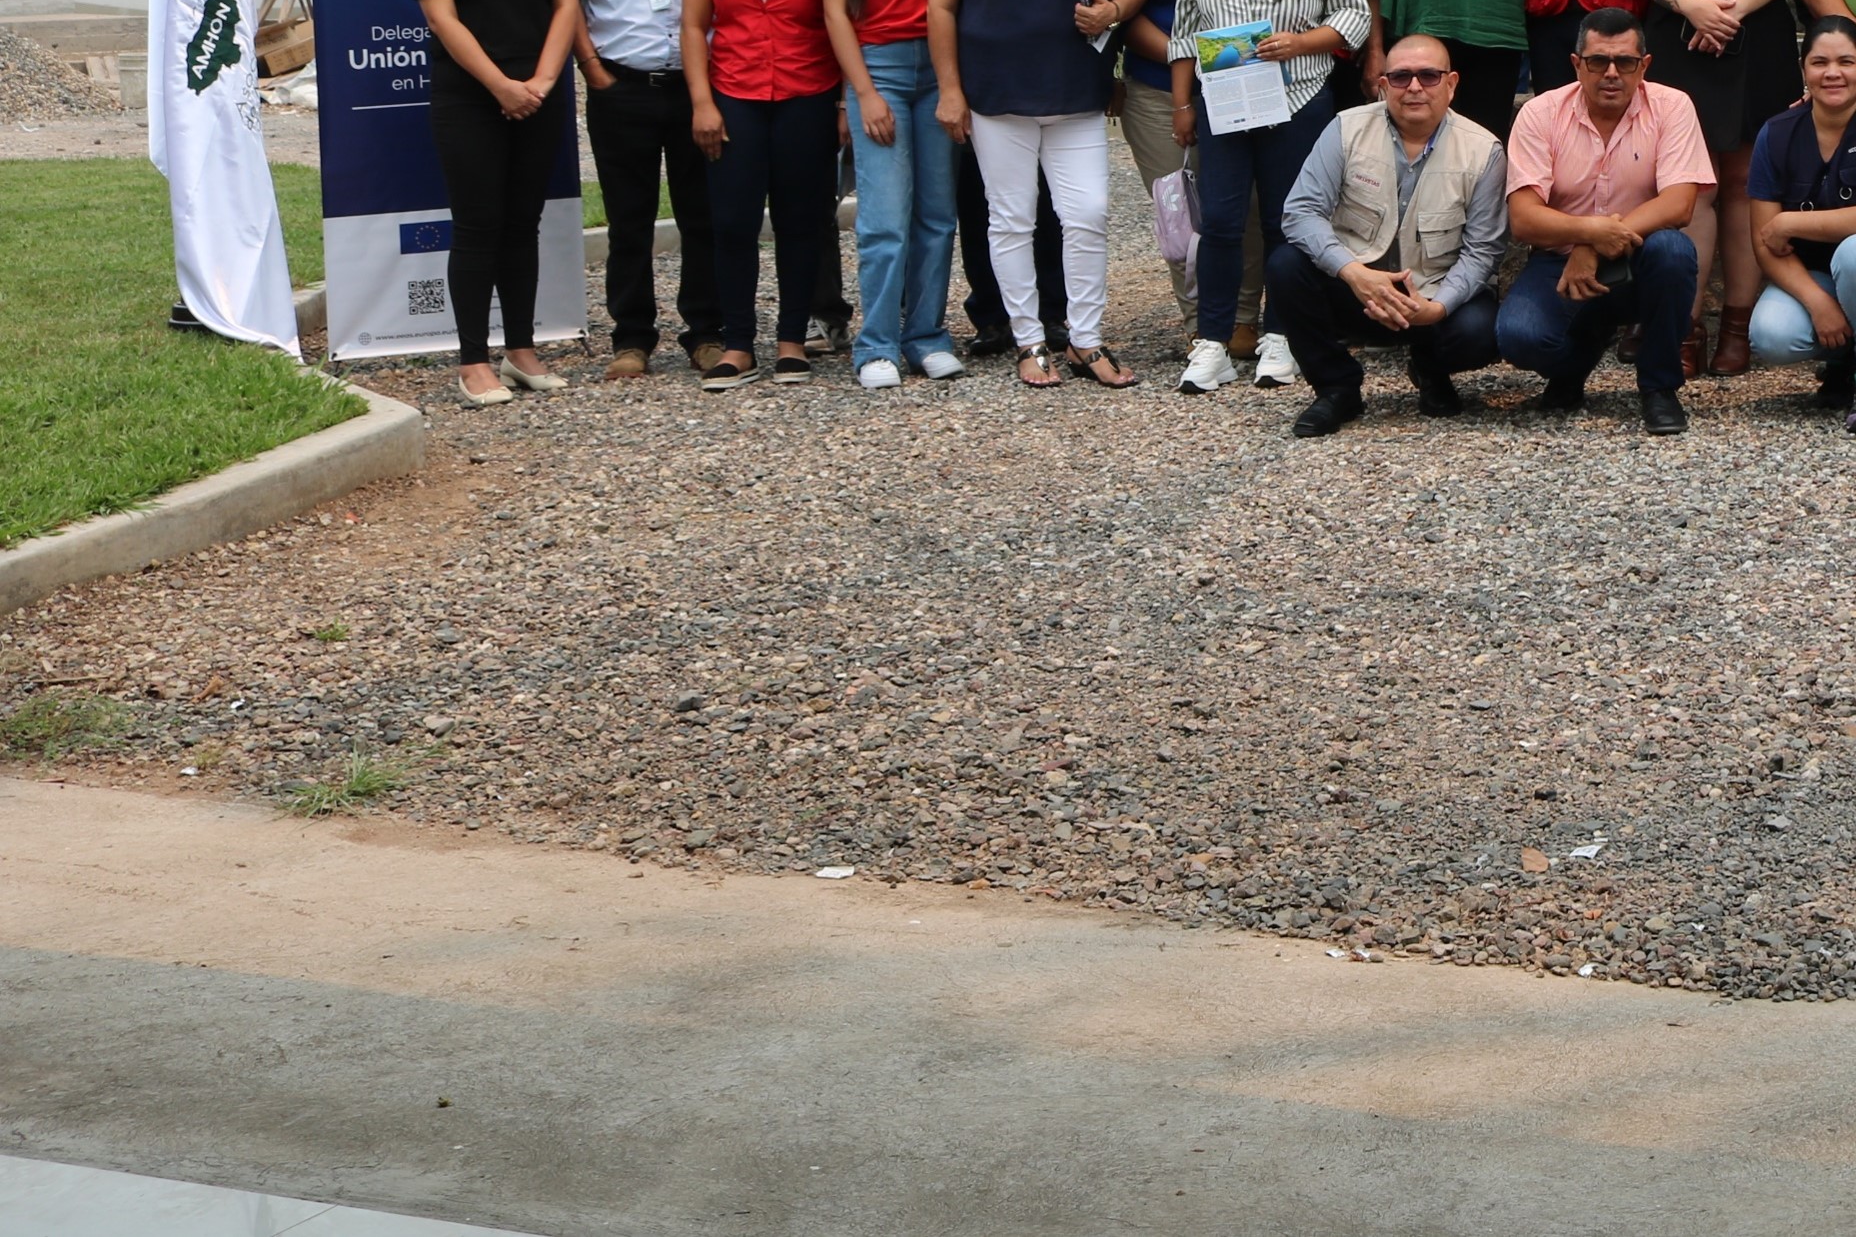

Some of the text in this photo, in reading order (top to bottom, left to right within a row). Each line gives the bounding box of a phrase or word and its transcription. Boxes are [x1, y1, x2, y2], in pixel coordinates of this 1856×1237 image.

[192, 2, 232, 80] AMHON
[371, 25, 432, 43] Delega
[348, 46, 427, 70] Unión
[392, 78, 414, 91] en
